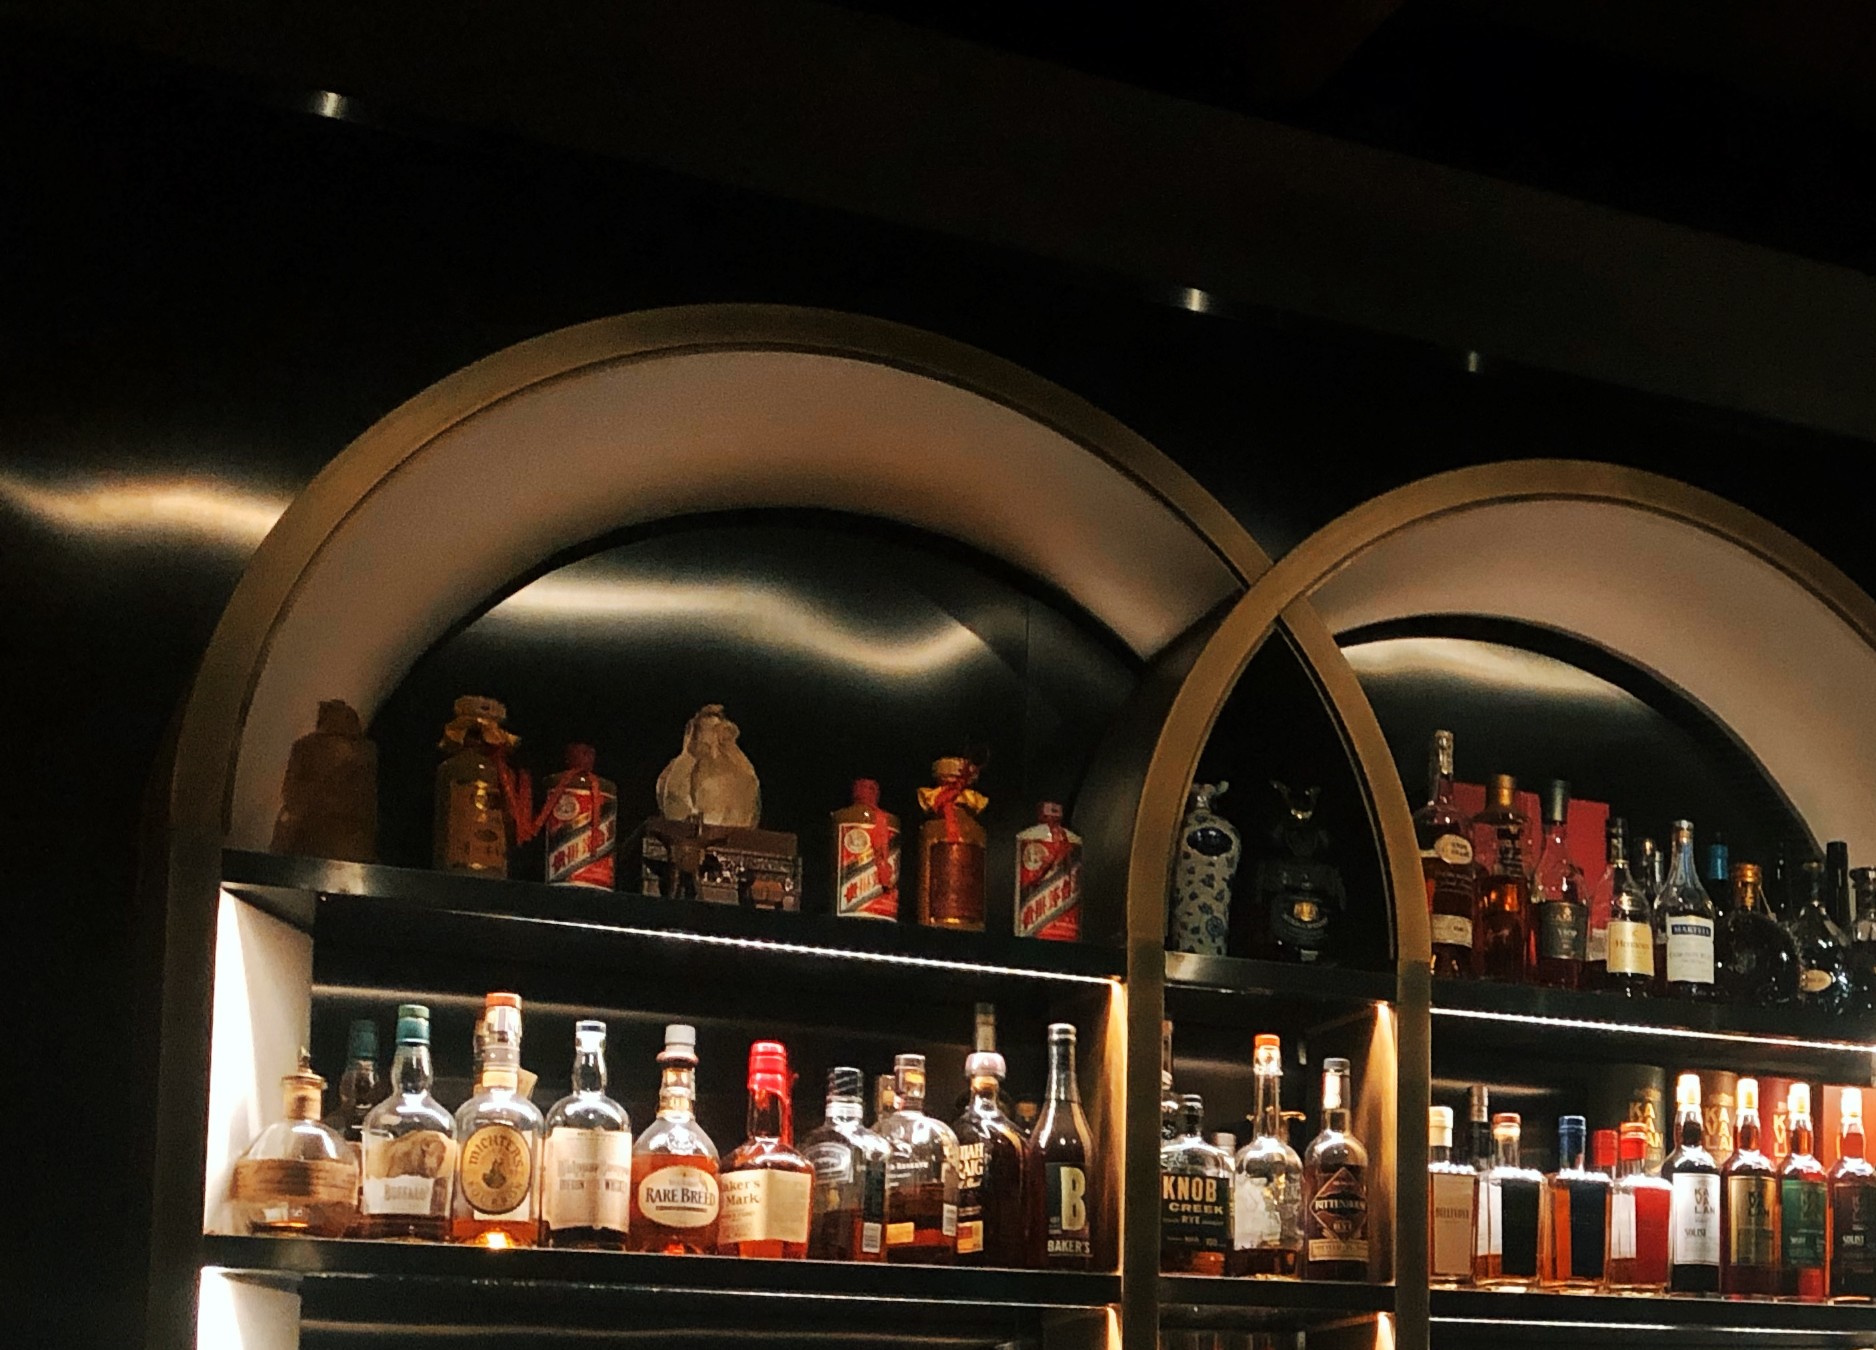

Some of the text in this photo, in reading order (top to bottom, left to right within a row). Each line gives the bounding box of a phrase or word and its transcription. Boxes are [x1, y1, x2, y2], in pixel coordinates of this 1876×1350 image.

[721, 1179, 761, 1193] aker's
[1162, 1175, 1217, 1203] KNOB
[645, 1187, 717, 1205] RARE BREED
[1060, 1166, 1086, 1231] B
[1168, 1202, 1225, 1215] CREEK
[1181, 1215, 1201, 1225] RYE
[1047, 1240, 1090, 1254] BAKER'S
